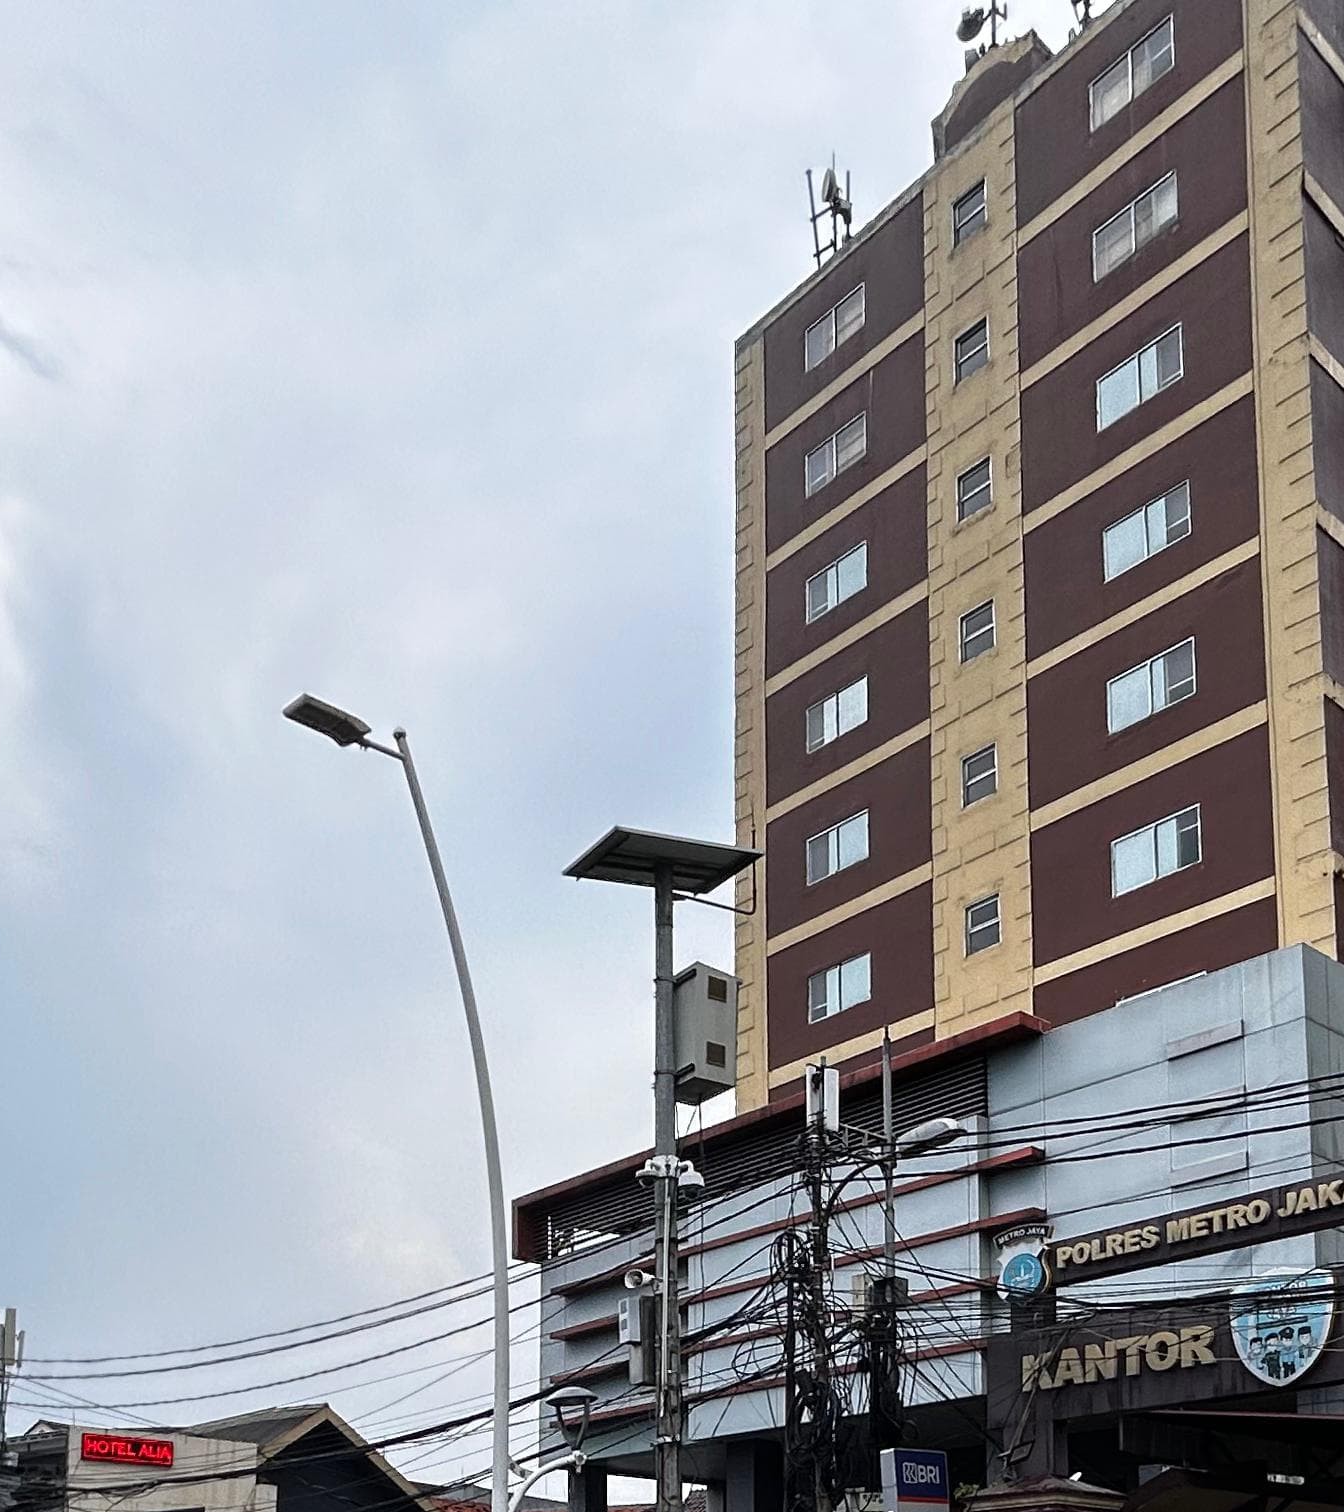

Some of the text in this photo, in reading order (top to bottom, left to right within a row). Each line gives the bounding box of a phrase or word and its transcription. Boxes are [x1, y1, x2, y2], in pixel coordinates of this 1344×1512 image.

[998, 1226, 1046, 1246] METRO JAYA
[1056, 1225, 1161, 1269] POLRES
[1166, 1199, 1272, 1245] METRO
[1022, 1325, 1217, 1393] KANTOR
[87, 1440, 172, 1459] HOTEL ALIA
[918, 1466, 940, 1484] BRI
